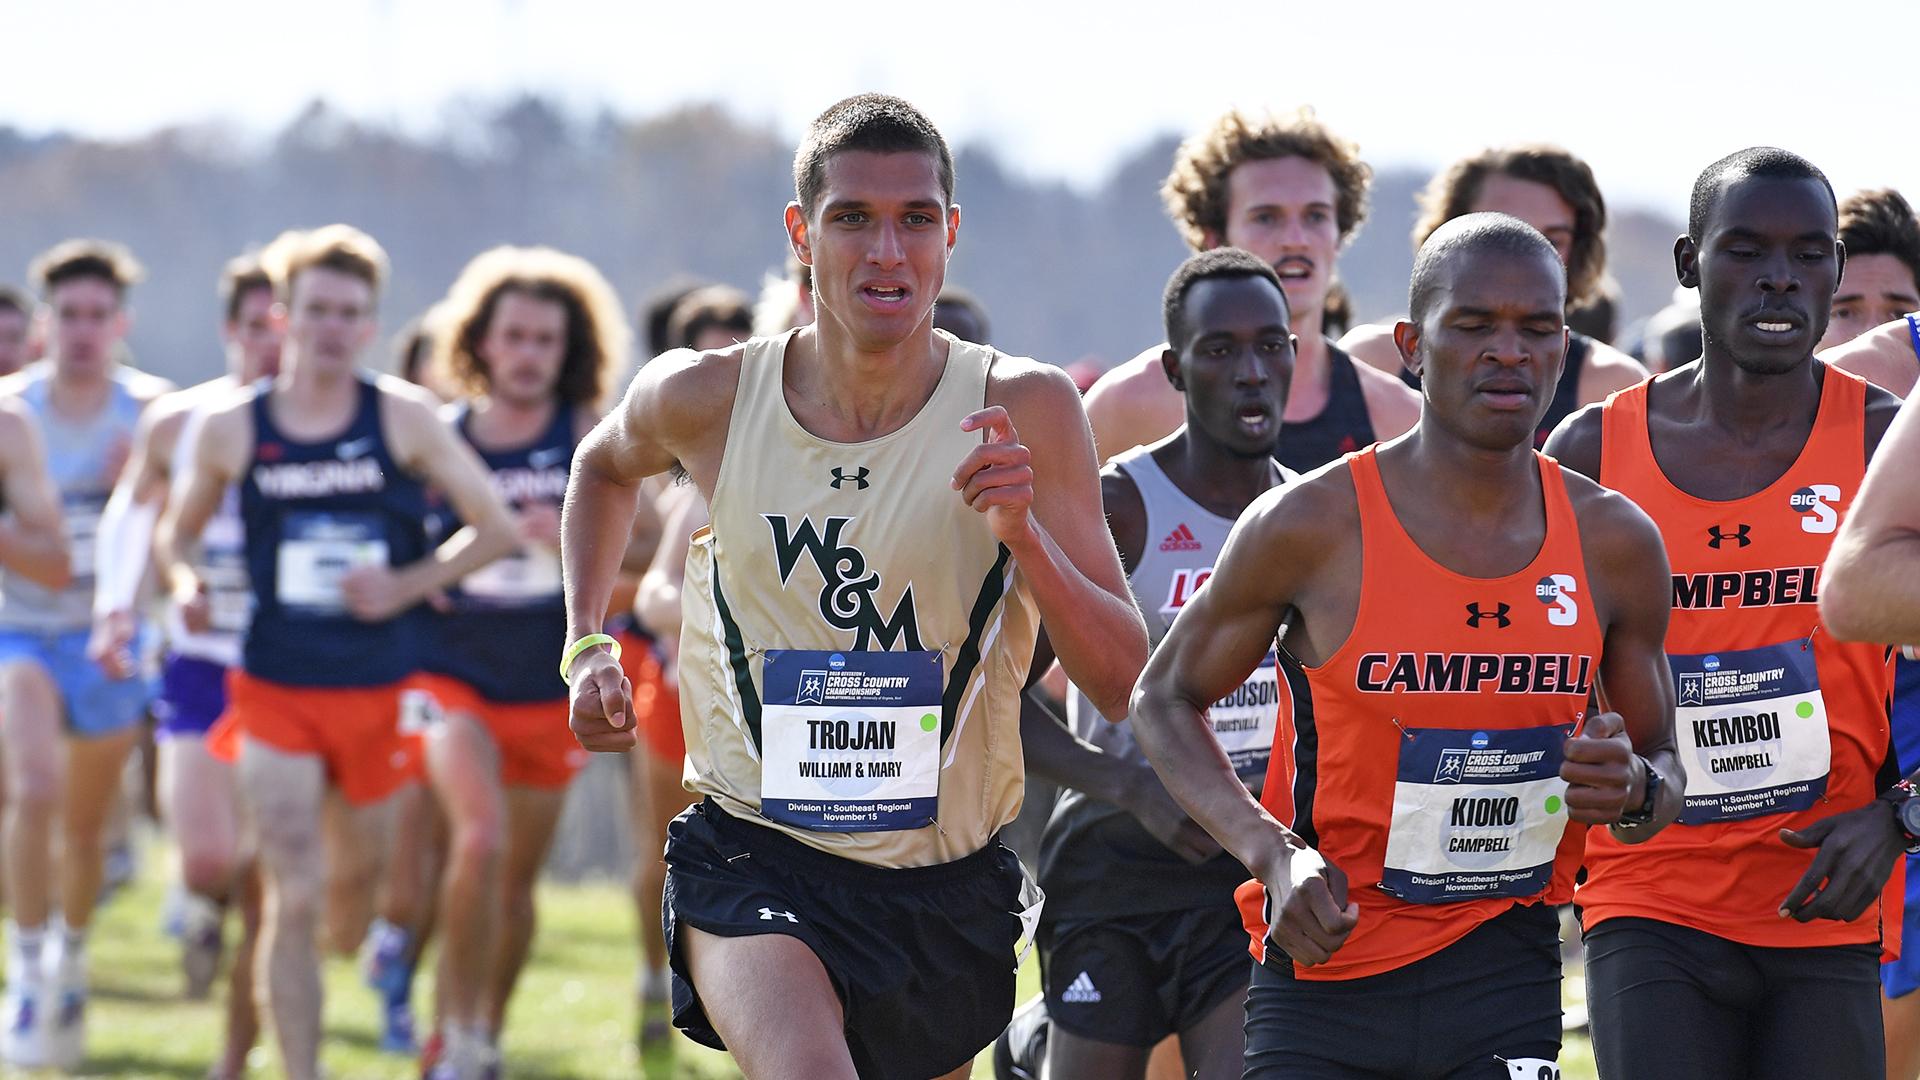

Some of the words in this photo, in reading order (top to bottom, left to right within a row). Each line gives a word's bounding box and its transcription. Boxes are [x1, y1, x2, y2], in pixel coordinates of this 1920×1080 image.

[1790, 493, 1816, 507] BIG
[1801, 484, 1841, 534] S
[1671, 566, 1820, 610] MPBEL
[1536, 583, 1558, 598] BIG
[1548, 574, 1578, 627] S
[1356, 652, 1592, 695] CAMPBELL
[1704, 675, 1738, 688] CROSS
[1739, 667, 1785, 685] COUNTRY
[827, 676, 861, 688] CROSS
[862, 676, 910, 688] COUNTRY
[1704, 683, 1759, 696] CHAMPIONSHIPS
[825, 687, 881, 696] CHAMPIONSHIPS
[1210, 681, 1278, 708] BOSON
[807, 720, 896, 750] TROJAN
[1692, 712, 1781, 748] KEMBOI
[1467, 754, 1502, 766] CROSS
[1502, 750, 1546, 766] COUNTRY
[1710, 752, 1773, 774] CAMPBELL
[799, 762, 850, 778] WILLIAM
[855, 762, 864, 778] &
[868, 761, 902, 777] MARY
[1464, 764, 1520, 774] CHAMPIONSHIPS
[1685, 798, 1719, 807] Division
[1729, 791, 1772, 804] Southeast
[1773, 784, 1809, 797] Regional
[788, 803, 821, 812] Division
[833, 803, 875, 812] Southeast
[877, 802, 912, 813] Regional
[1451, 797, 1519, 827] KIOKO
[1721, 800, 1764, 813] November
[1766, 798, 1776, 806] 15
[823, 813, 866, 821] November
[1449, 837, 1510, 853] CAMPBELL
[1411, 876, 1445, 886] Division
[1456, 875, 1498, 883] Southeast
[1499, 871, 1534, 882] Regional
[1445, 883, 1488, 892] November
[1489, 882, 1499, 890] 15
